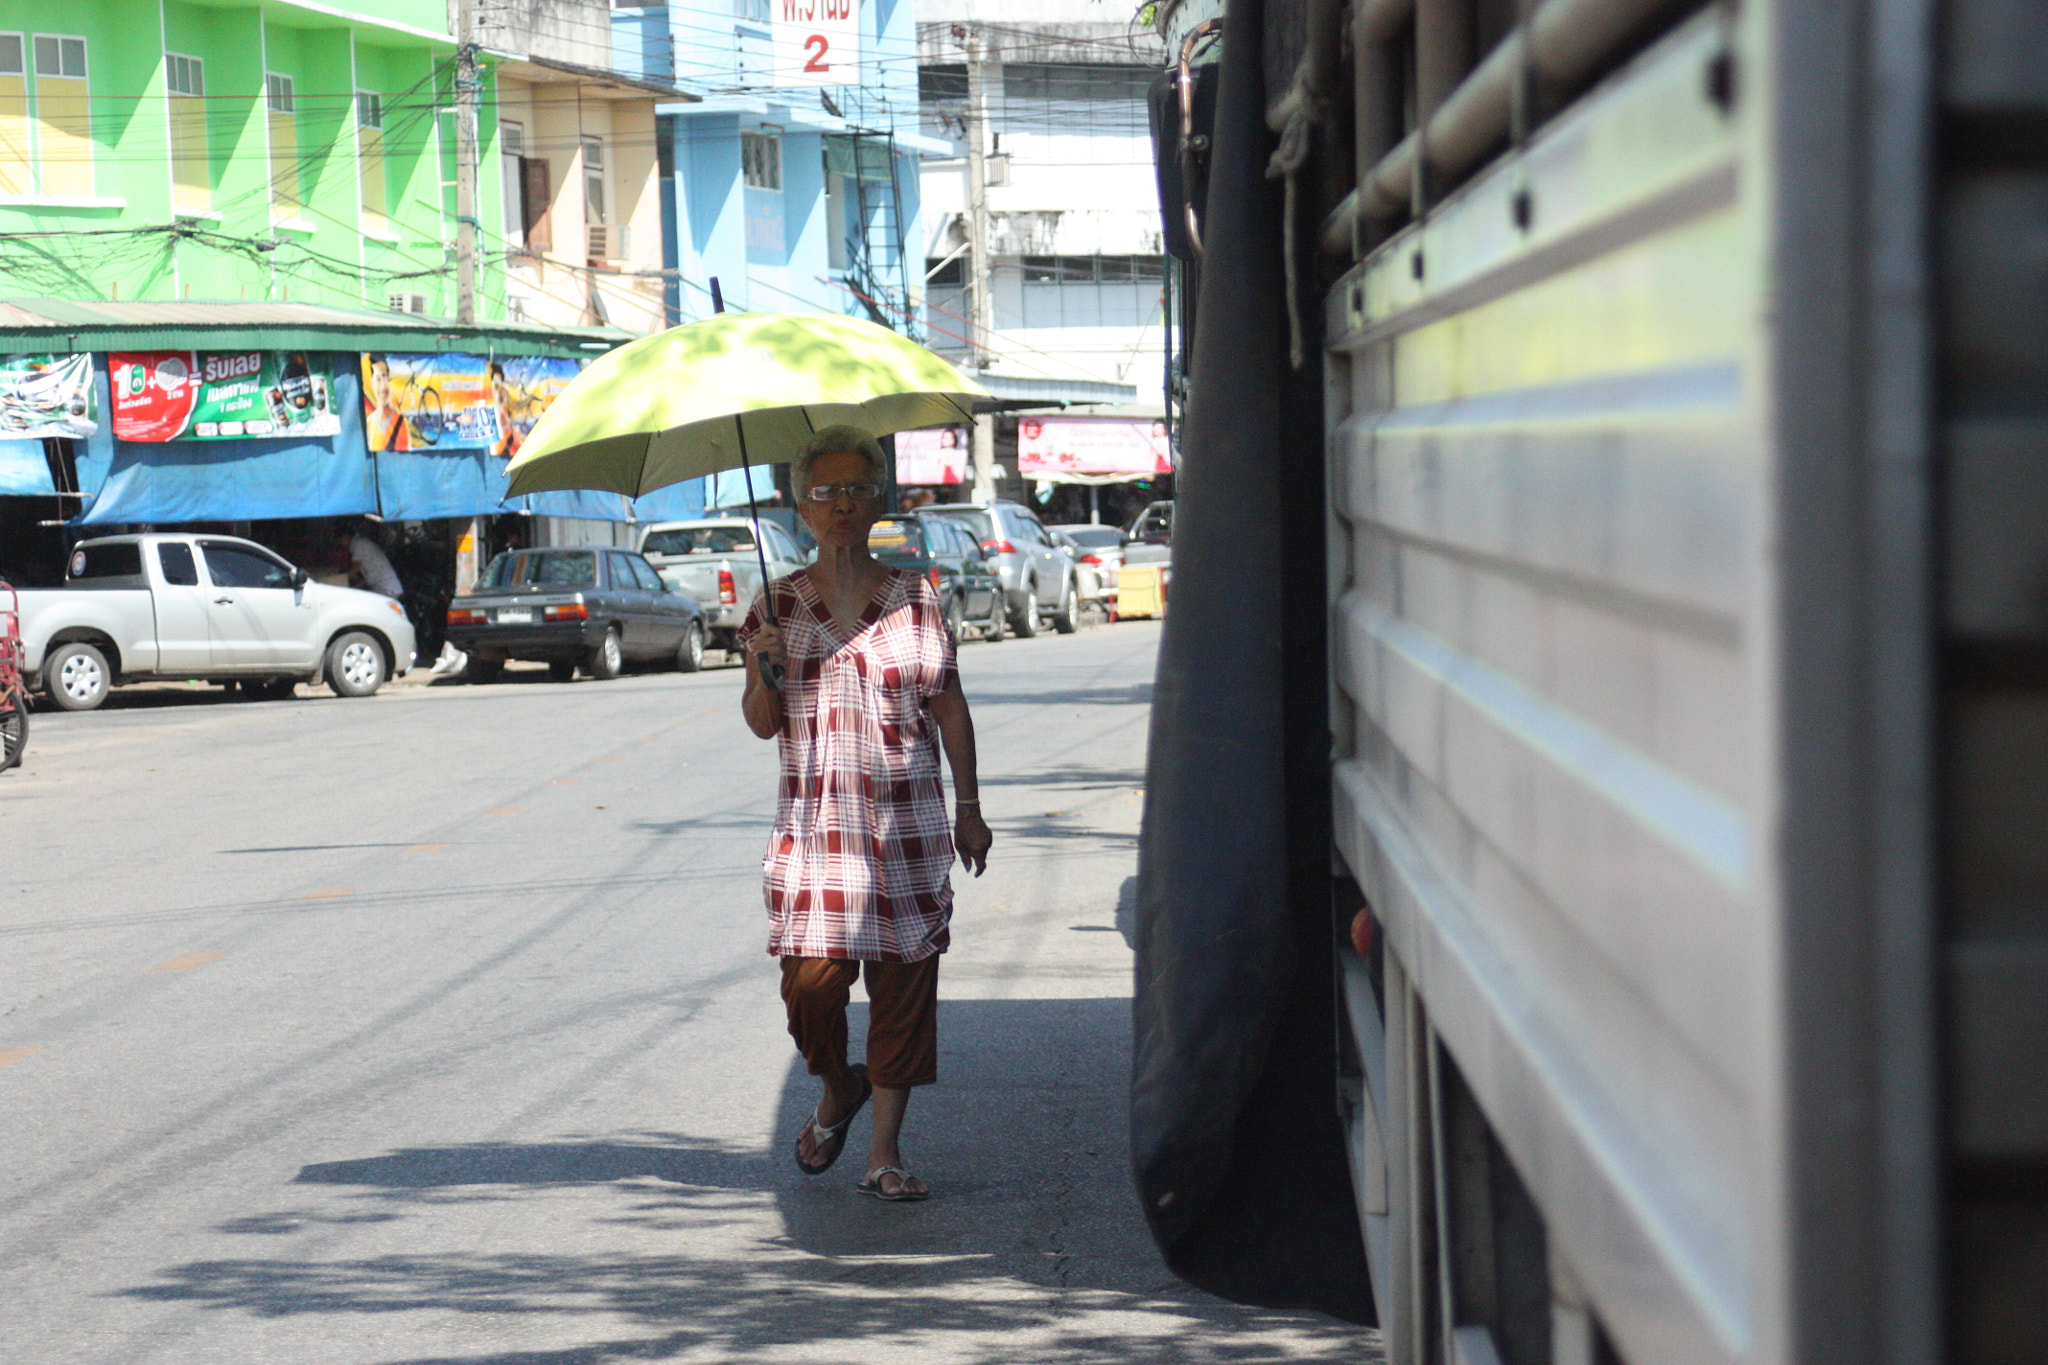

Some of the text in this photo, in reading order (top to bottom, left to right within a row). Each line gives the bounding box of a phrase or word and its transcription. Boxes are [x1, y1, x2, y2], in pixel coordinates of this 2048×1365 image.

[803, 34, 829, 73] 2
[206, 352, 262, 383] รับเลย
